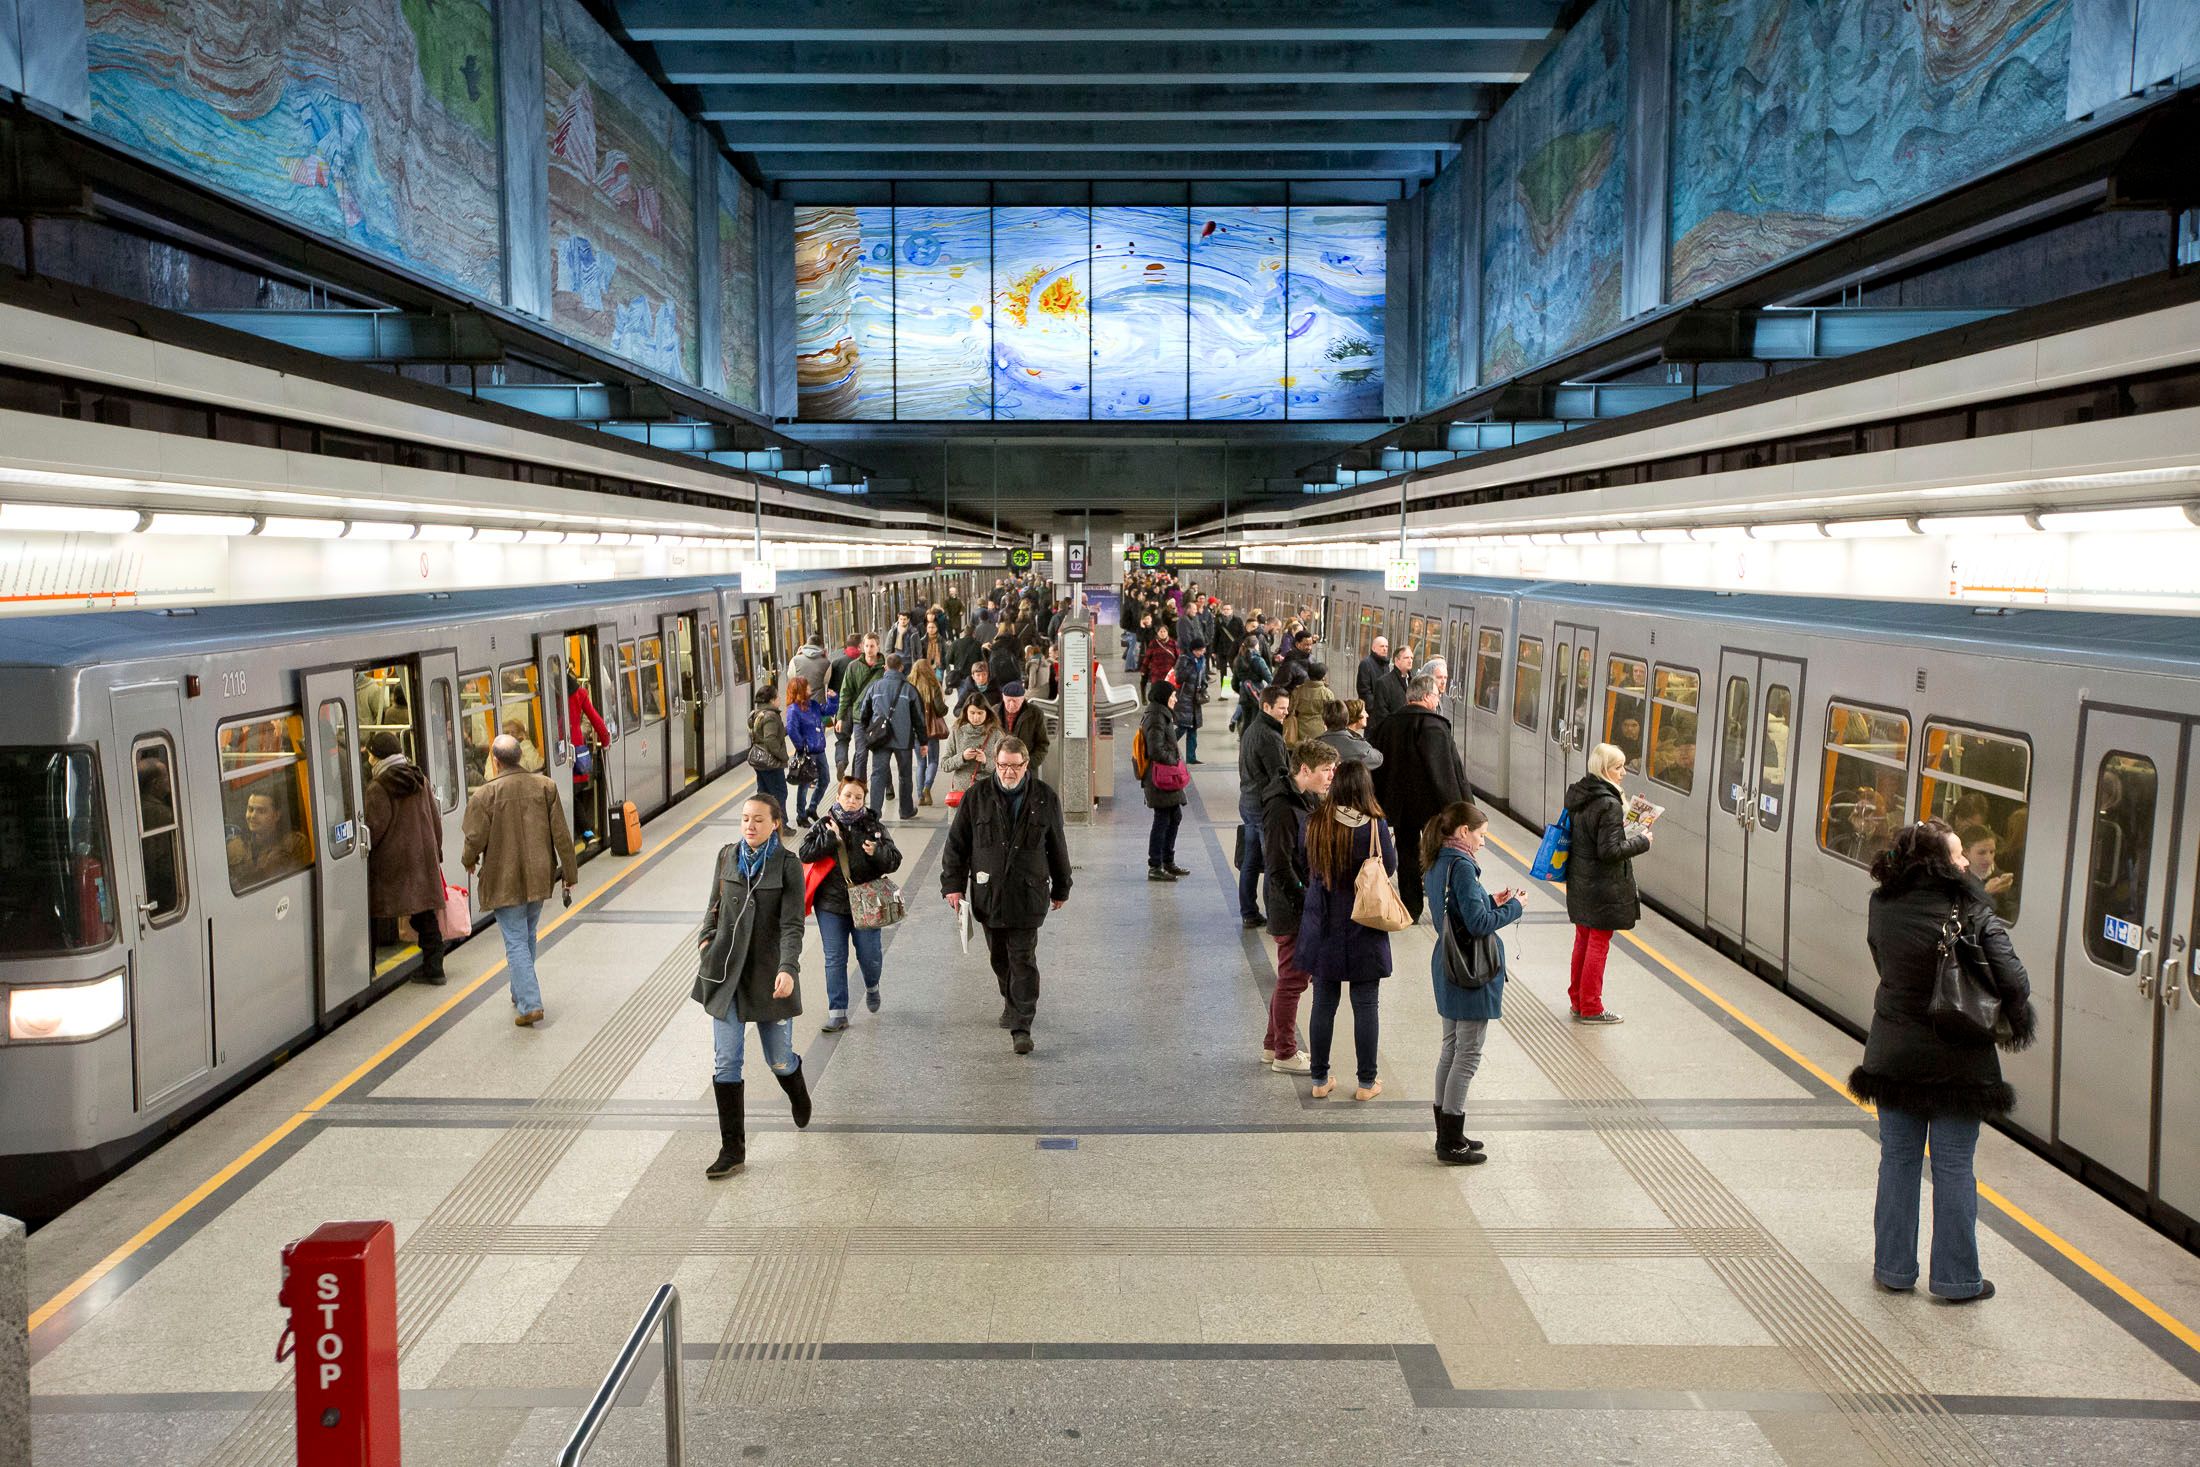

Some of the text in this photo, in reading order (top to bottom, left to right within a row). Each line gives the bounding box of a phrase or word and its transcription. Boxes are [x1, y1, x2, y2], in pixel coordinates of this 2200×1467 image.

[1070, 562, 1082, 571] U2
[222, 670, 247, 698] 2118
[316, 1272, 343, 1390] STOP
